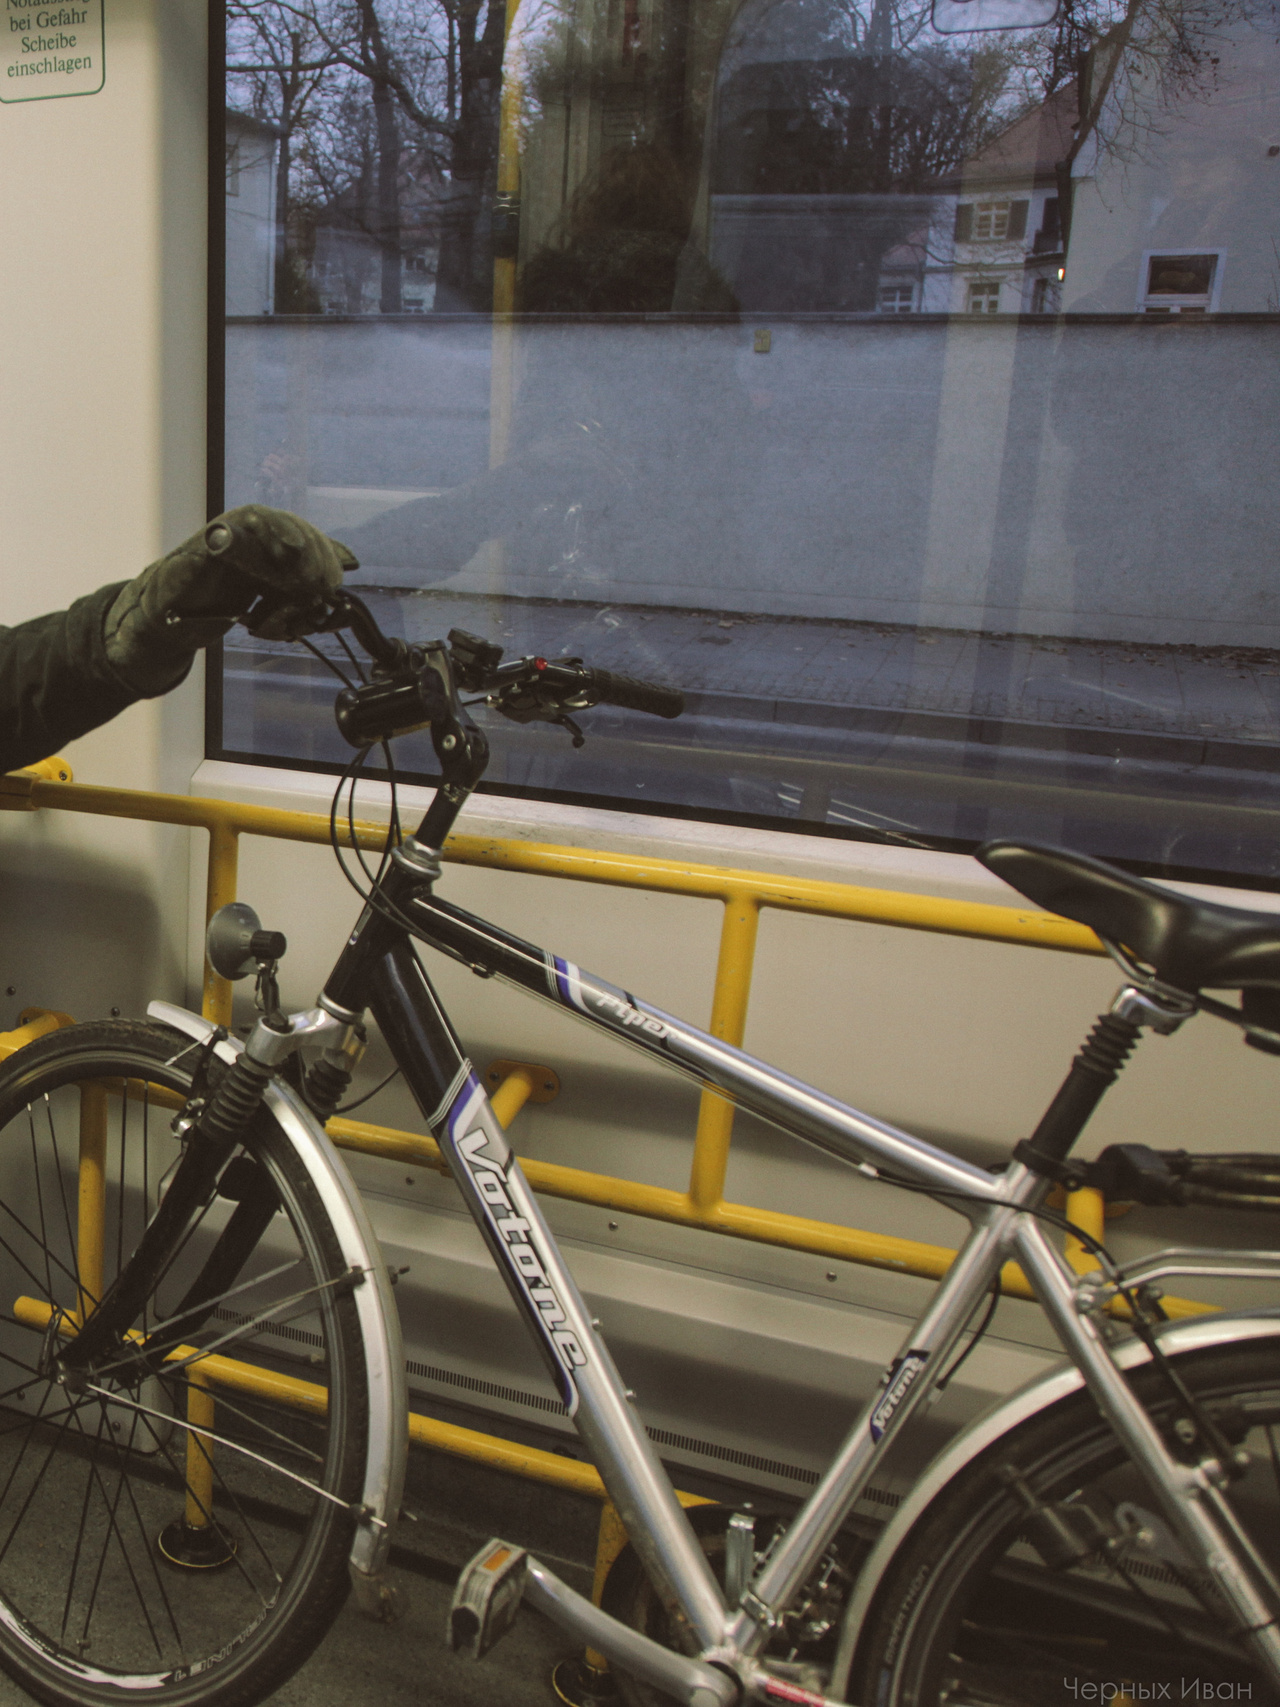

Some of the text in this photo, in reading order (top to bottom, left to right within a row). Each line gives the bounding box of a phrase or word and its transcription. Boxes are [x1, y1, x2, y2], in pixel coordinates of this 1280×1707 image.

[9, 8, 88, 32] bei Gefahr
[21, 32, 77, 53] Scheibe
[7, 56, 92, 77] einschlagen
[456, 1126, 588, 1370] Votone
